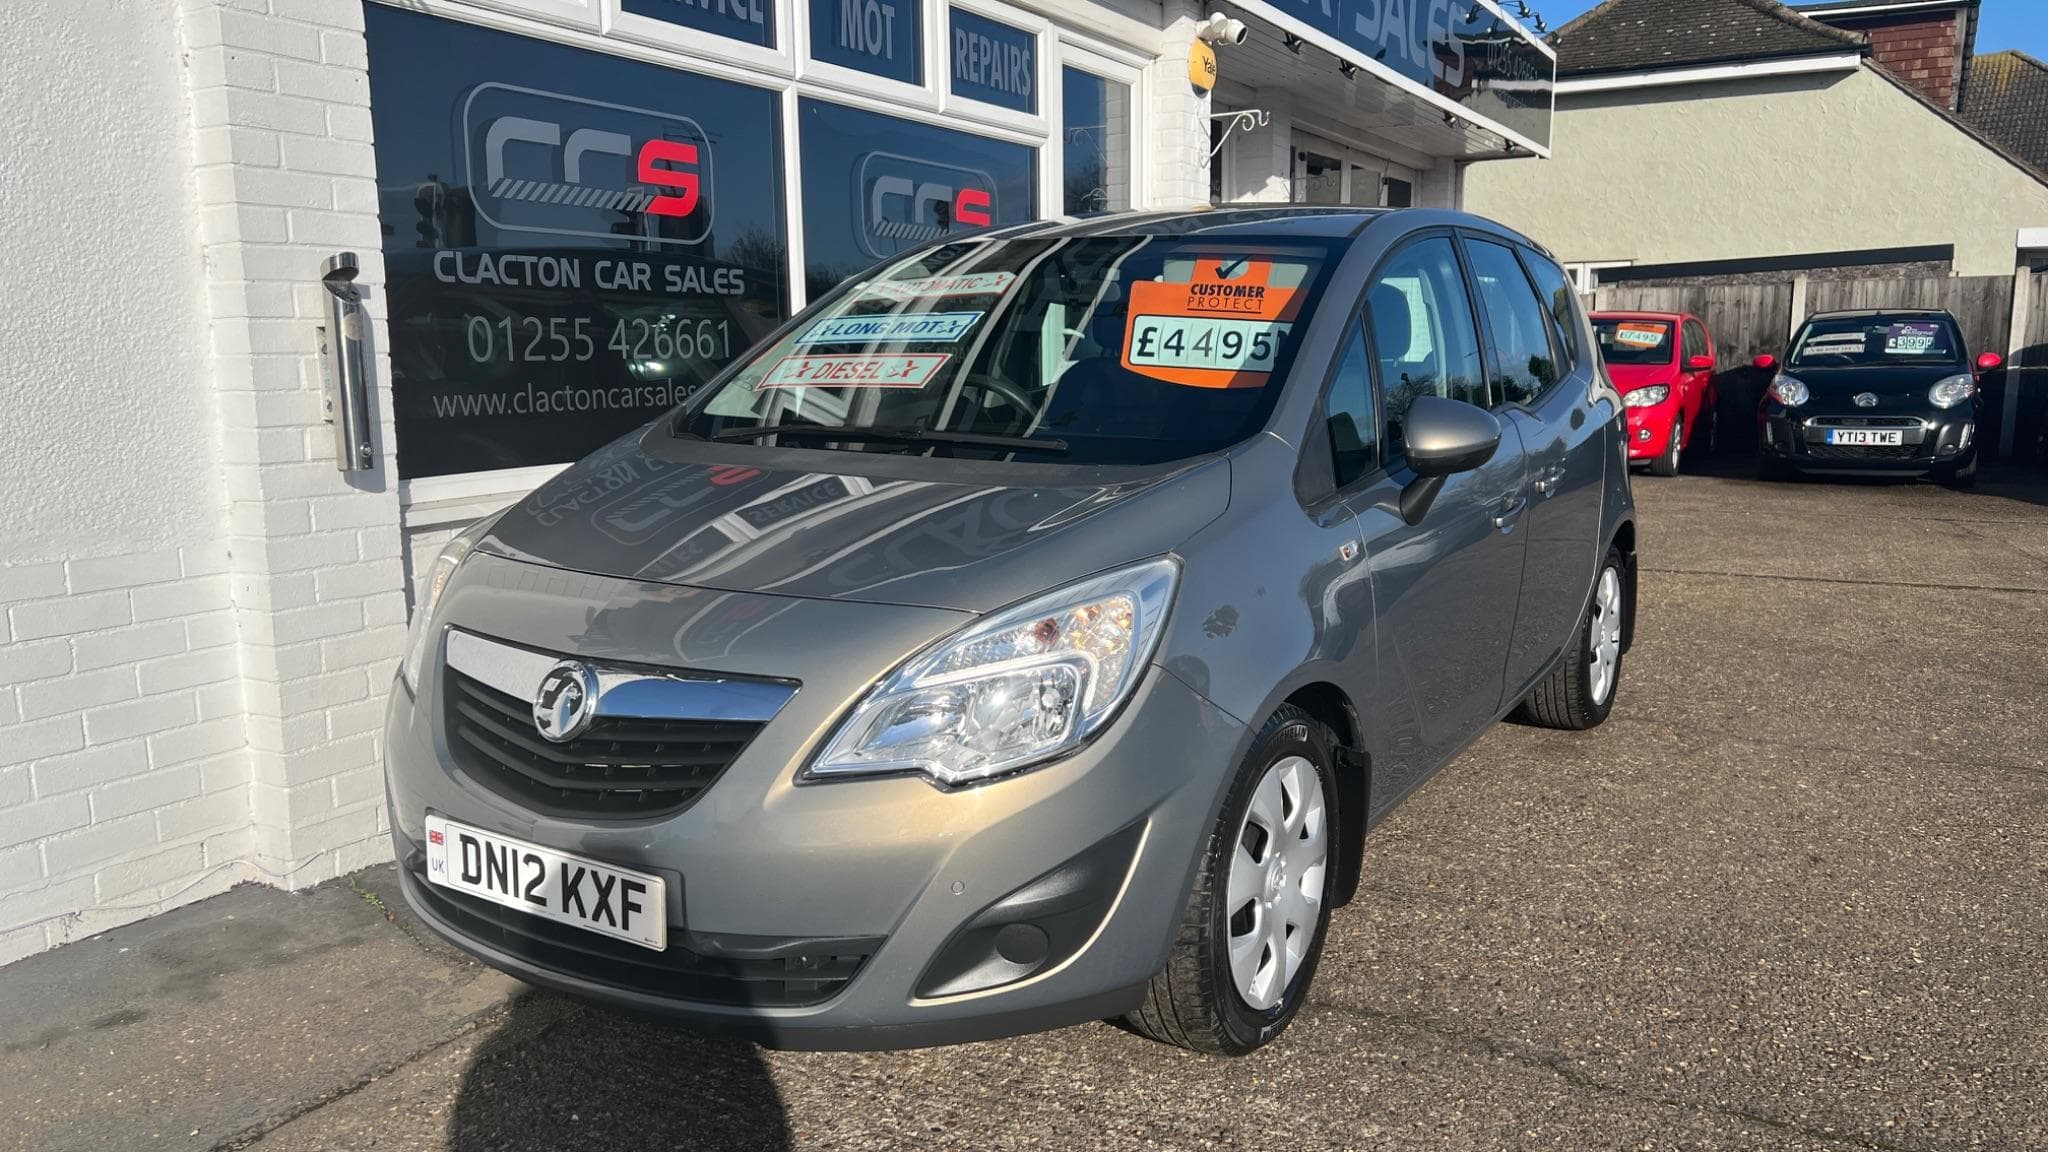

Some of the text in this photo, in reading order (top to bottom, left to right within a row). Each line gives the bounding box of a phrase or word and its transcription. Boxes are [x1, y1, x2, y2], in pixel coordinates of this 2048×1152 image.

[840, 0, 895, 59] MOT
[955, 28, 1032, 97] REPAIRS
[1202, 55, 1216, 77] Yale
[434, 250, 745, 295] CLACTON CAR SALES
[1190, 283, 1265, 299] CUSTOMER
[1187, 296, 1265, 311] PROTECT
[832, 320, 943, 335] LONG MOT
[467, 315, 731, 363] 01255 426661
[1136, 326, 1273, 361] £4495
[811, 361, 885, 379] DIESEL
[1838, 432, 1897, 443] YT13 TWE
[432, 857, 445, 873] UK
[459, 833, 647, 932] DN12 KXF
